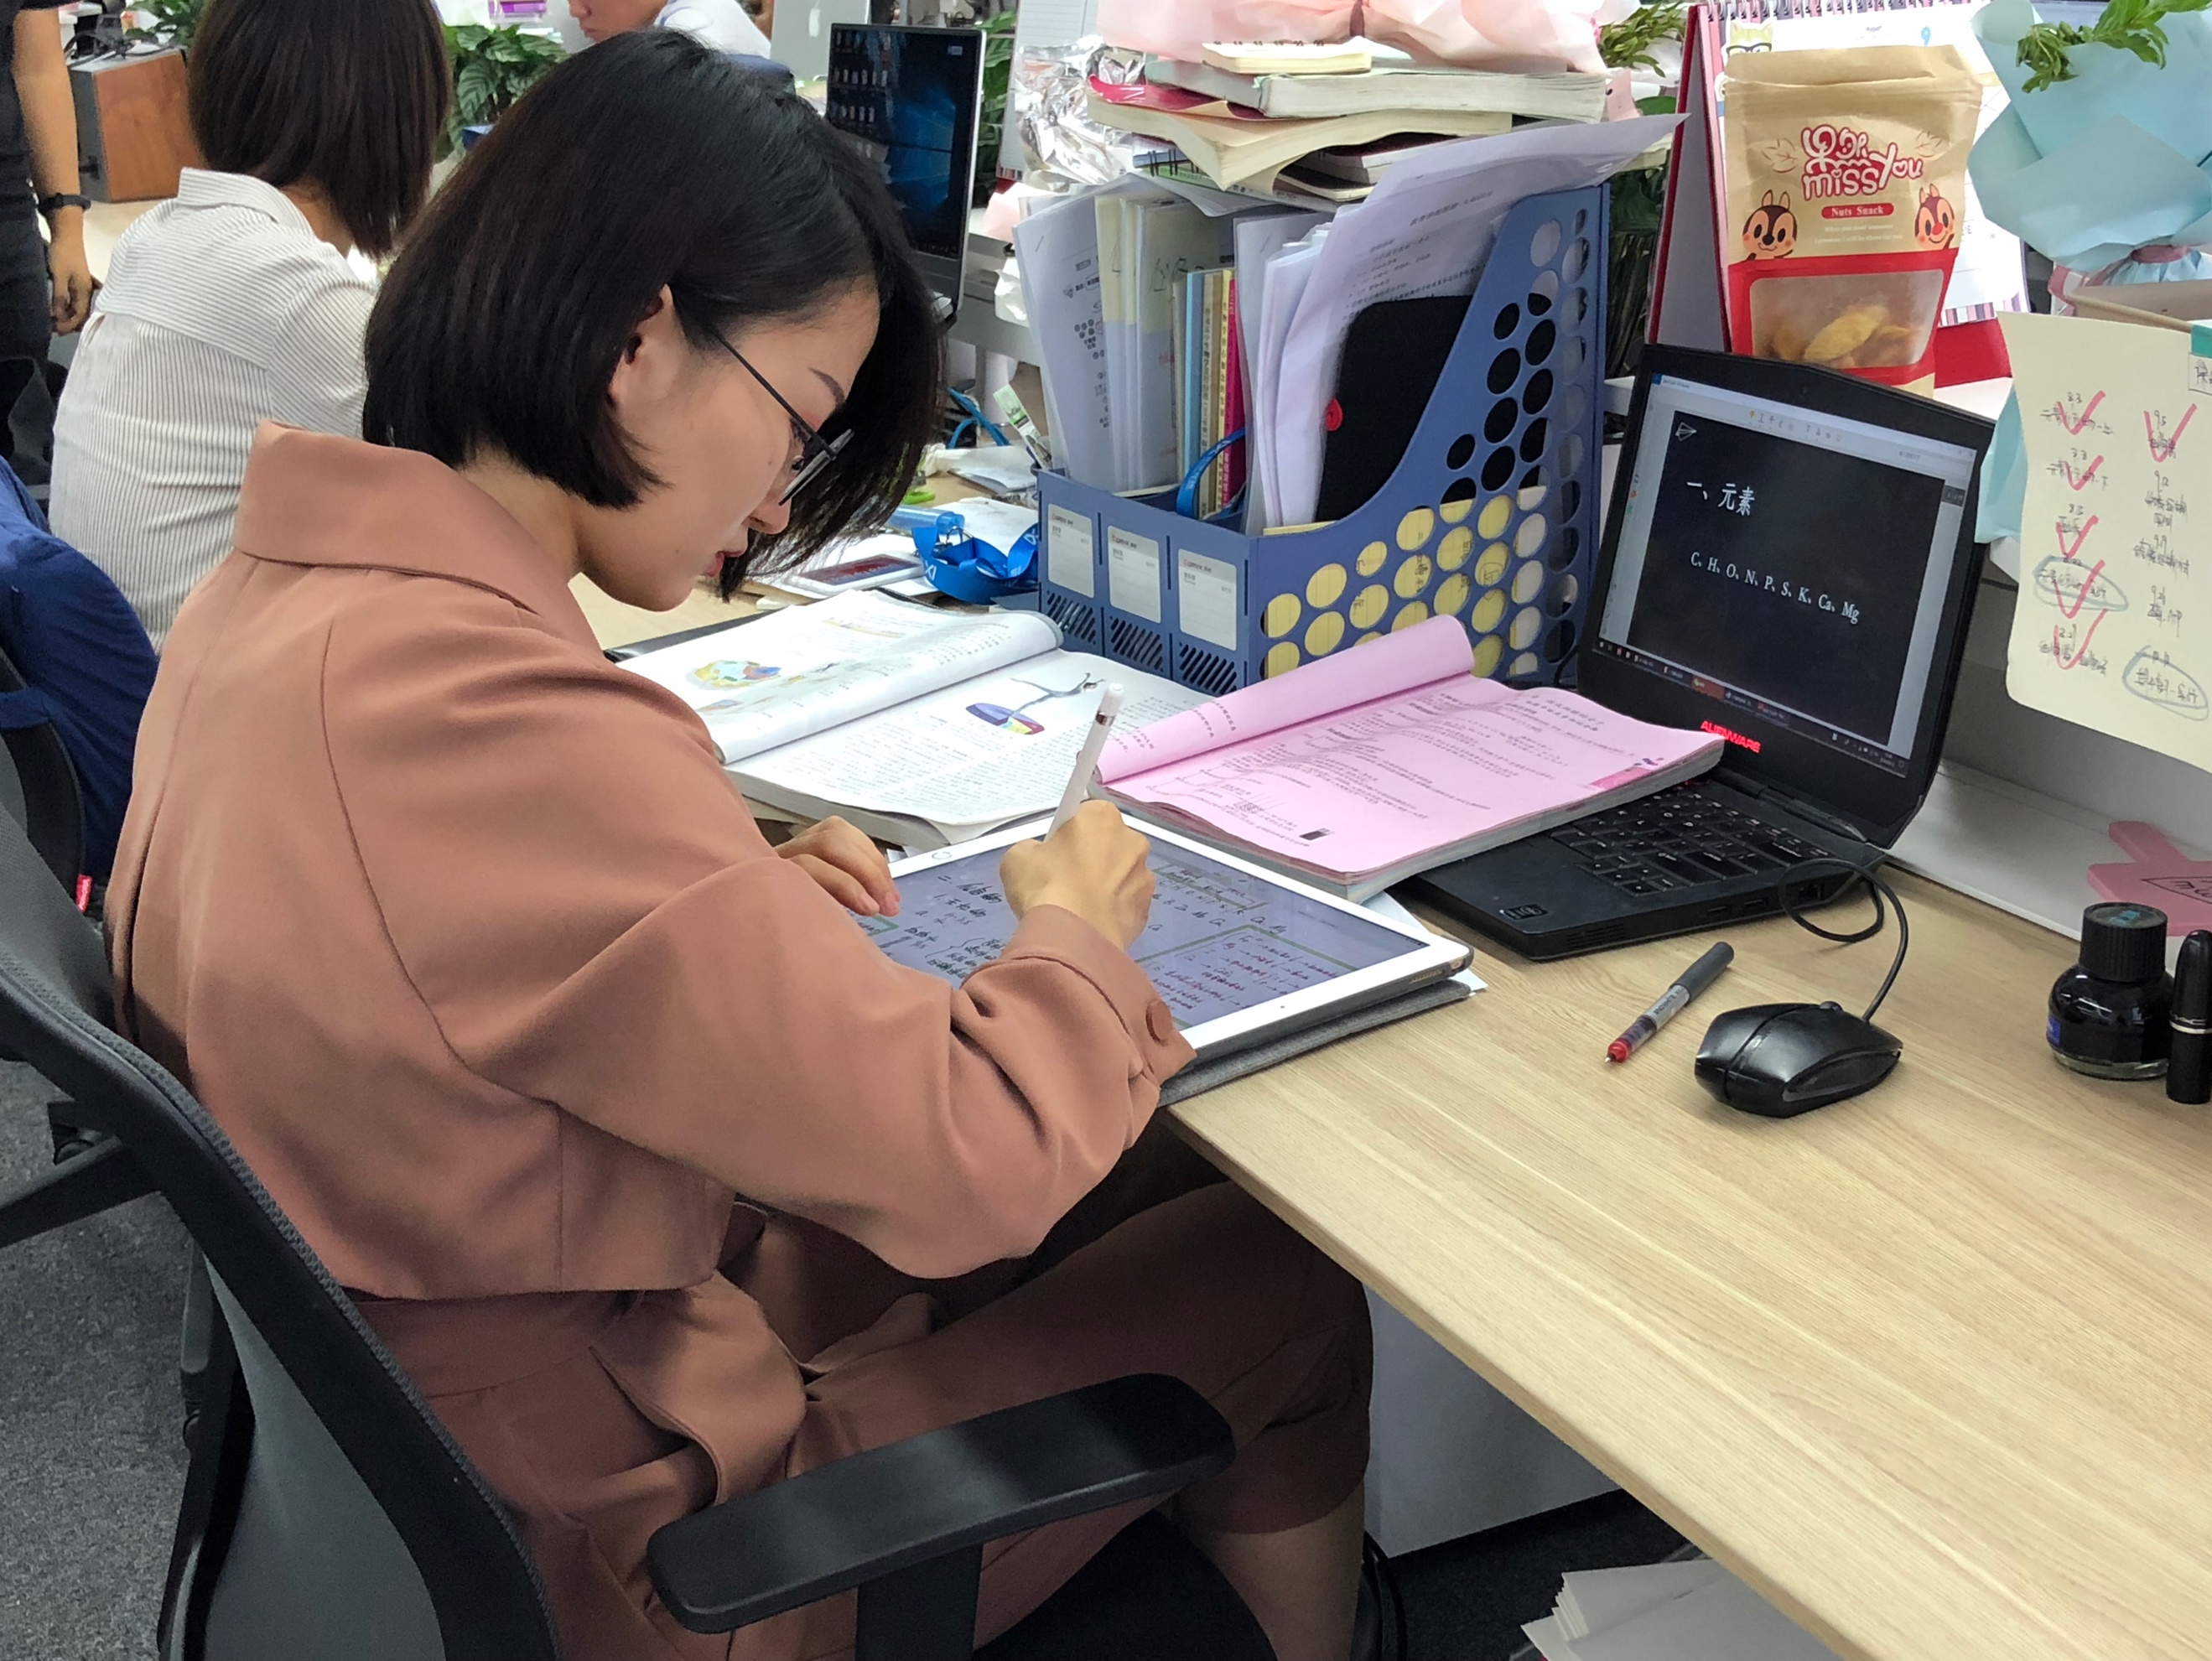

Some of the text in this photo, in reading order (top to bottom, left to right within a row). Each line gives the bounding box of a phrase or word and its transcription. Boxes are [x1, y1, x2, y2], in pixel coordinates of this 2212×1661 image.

[1804, 169, 1878, 200] miss
[1831, 205, 1884, 216] Nuts Snack
[1686, 480, 1755, 516] 一、元素
[1701, 720, 1761, 754] ALIENWARE
